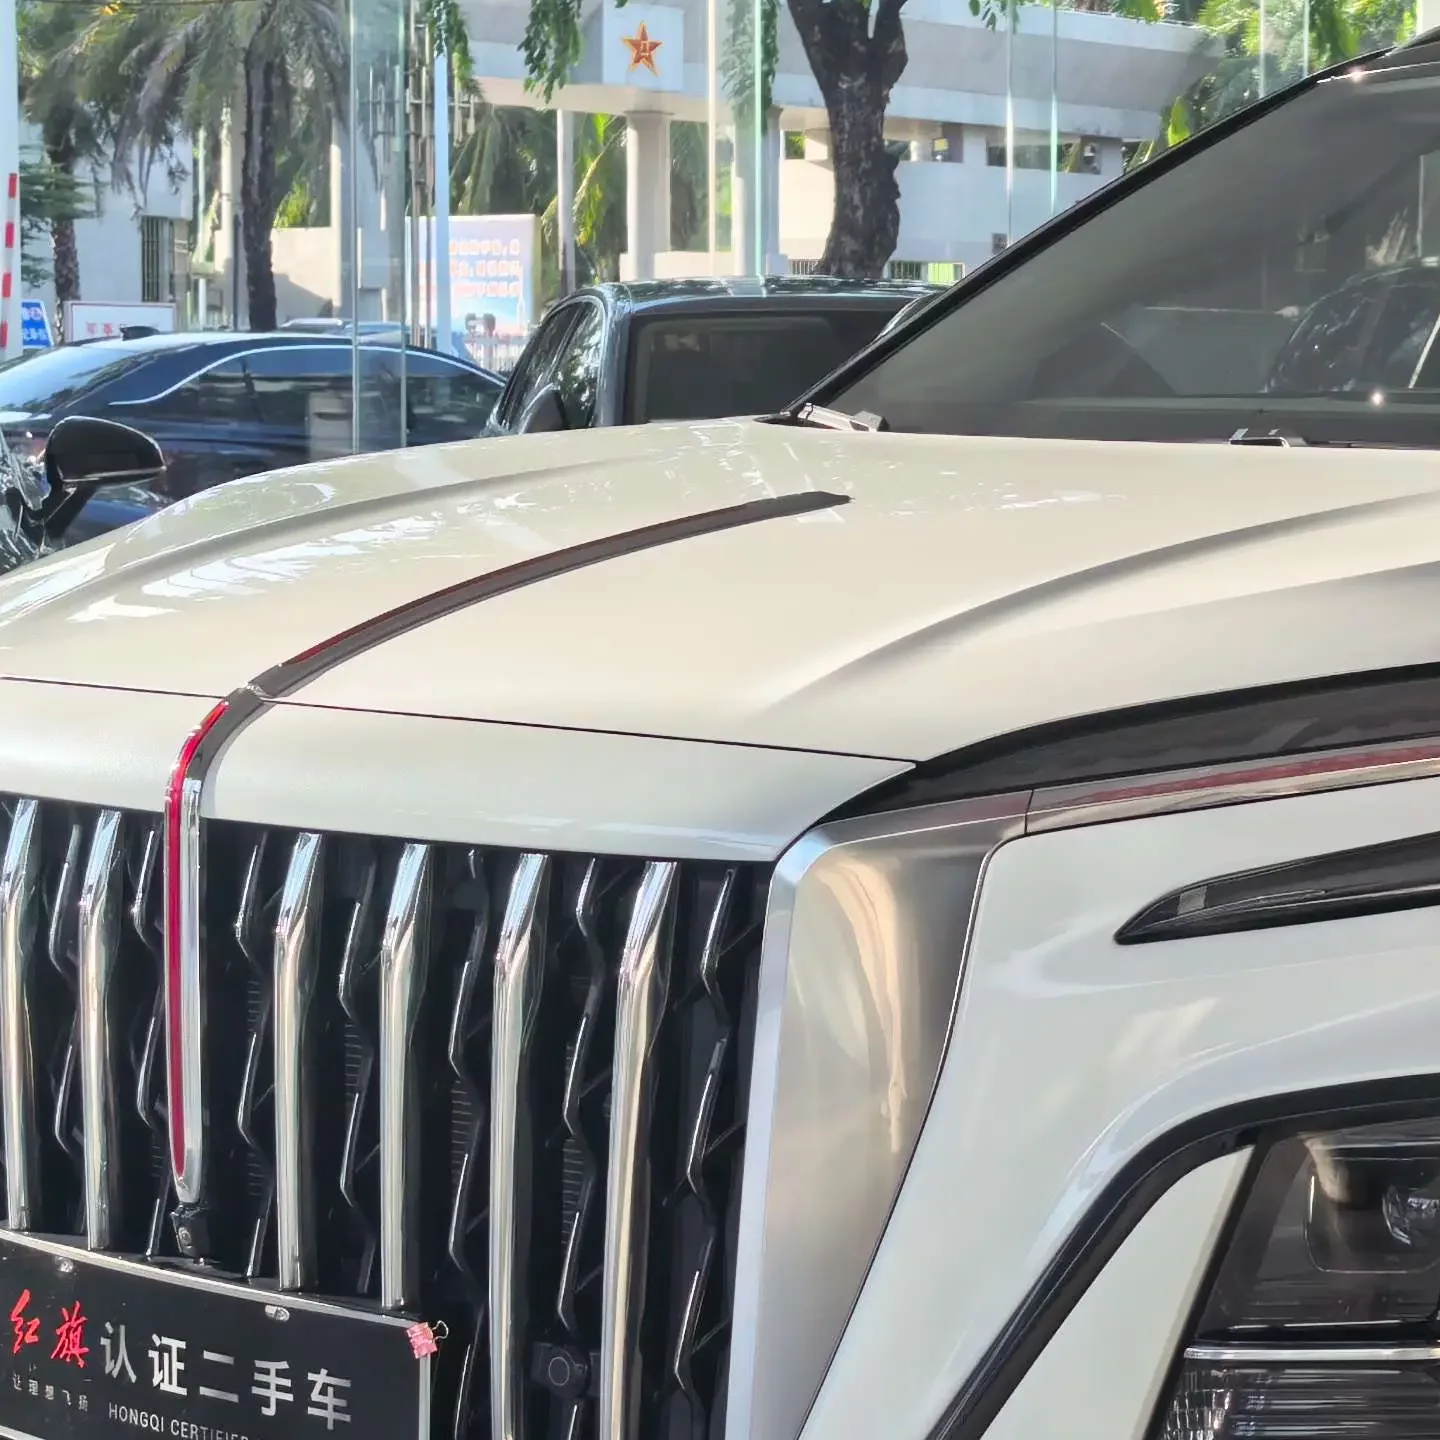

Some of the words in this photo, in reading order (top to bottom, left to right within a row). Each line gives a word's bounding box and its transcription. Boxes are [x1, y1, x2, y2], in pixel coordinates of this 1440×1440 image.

[9, 1287, 353, 1431] 红旗认证二手车
[108, 1401, 165, 1434] HONGQI
